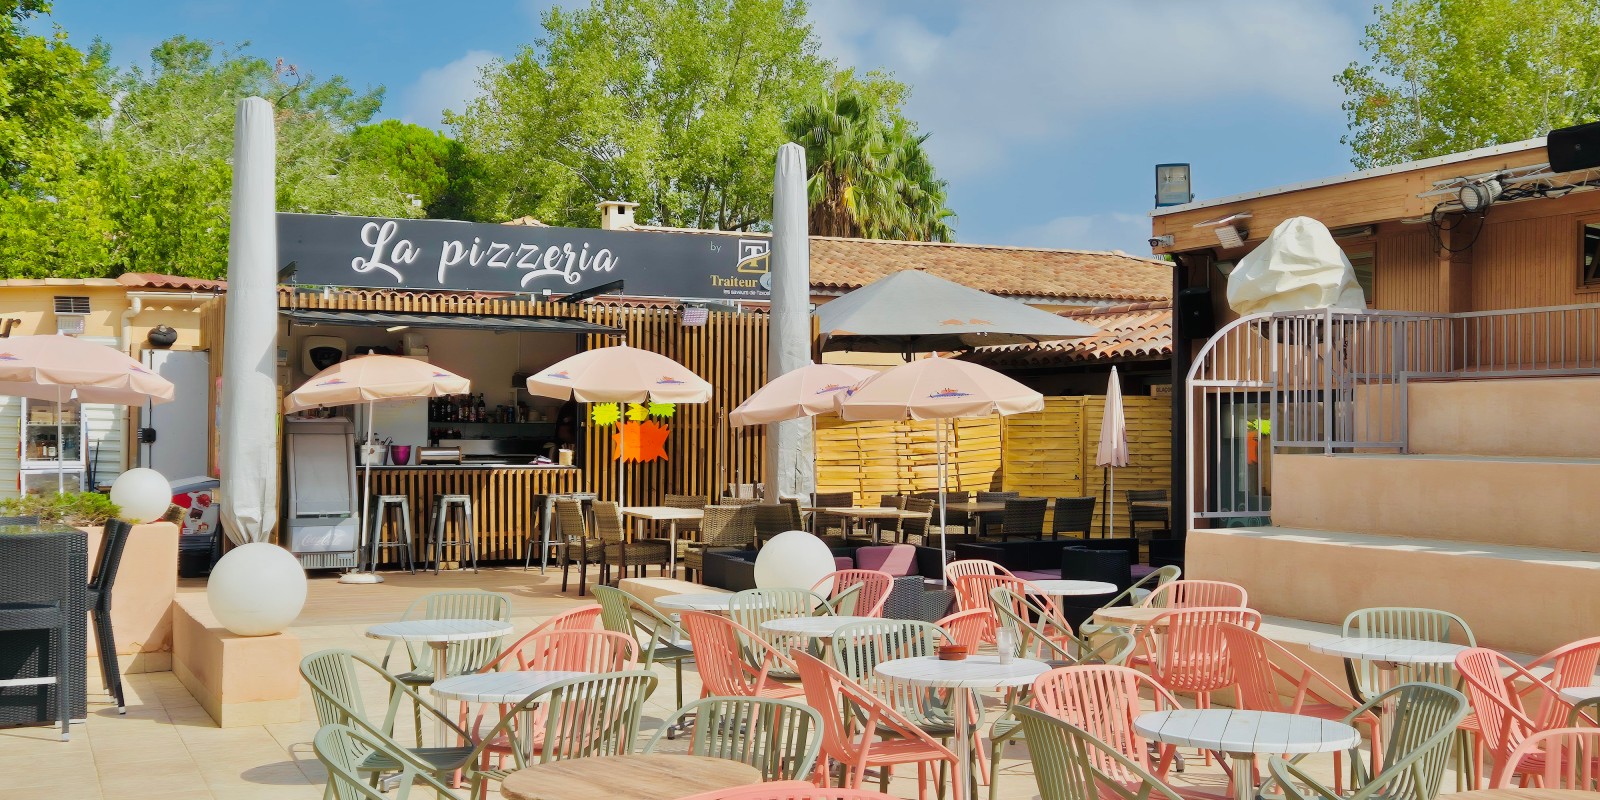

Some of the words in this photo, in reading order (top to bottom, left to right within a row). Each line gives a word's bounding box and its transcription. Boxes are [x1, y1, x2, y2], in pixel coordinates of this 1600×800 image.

[710, 240, 722, 253] by
[351, 220, 421, 283] La
[437, 236, 619, 288] pizzeria
[709, 274, 758, 287] Traiteur
